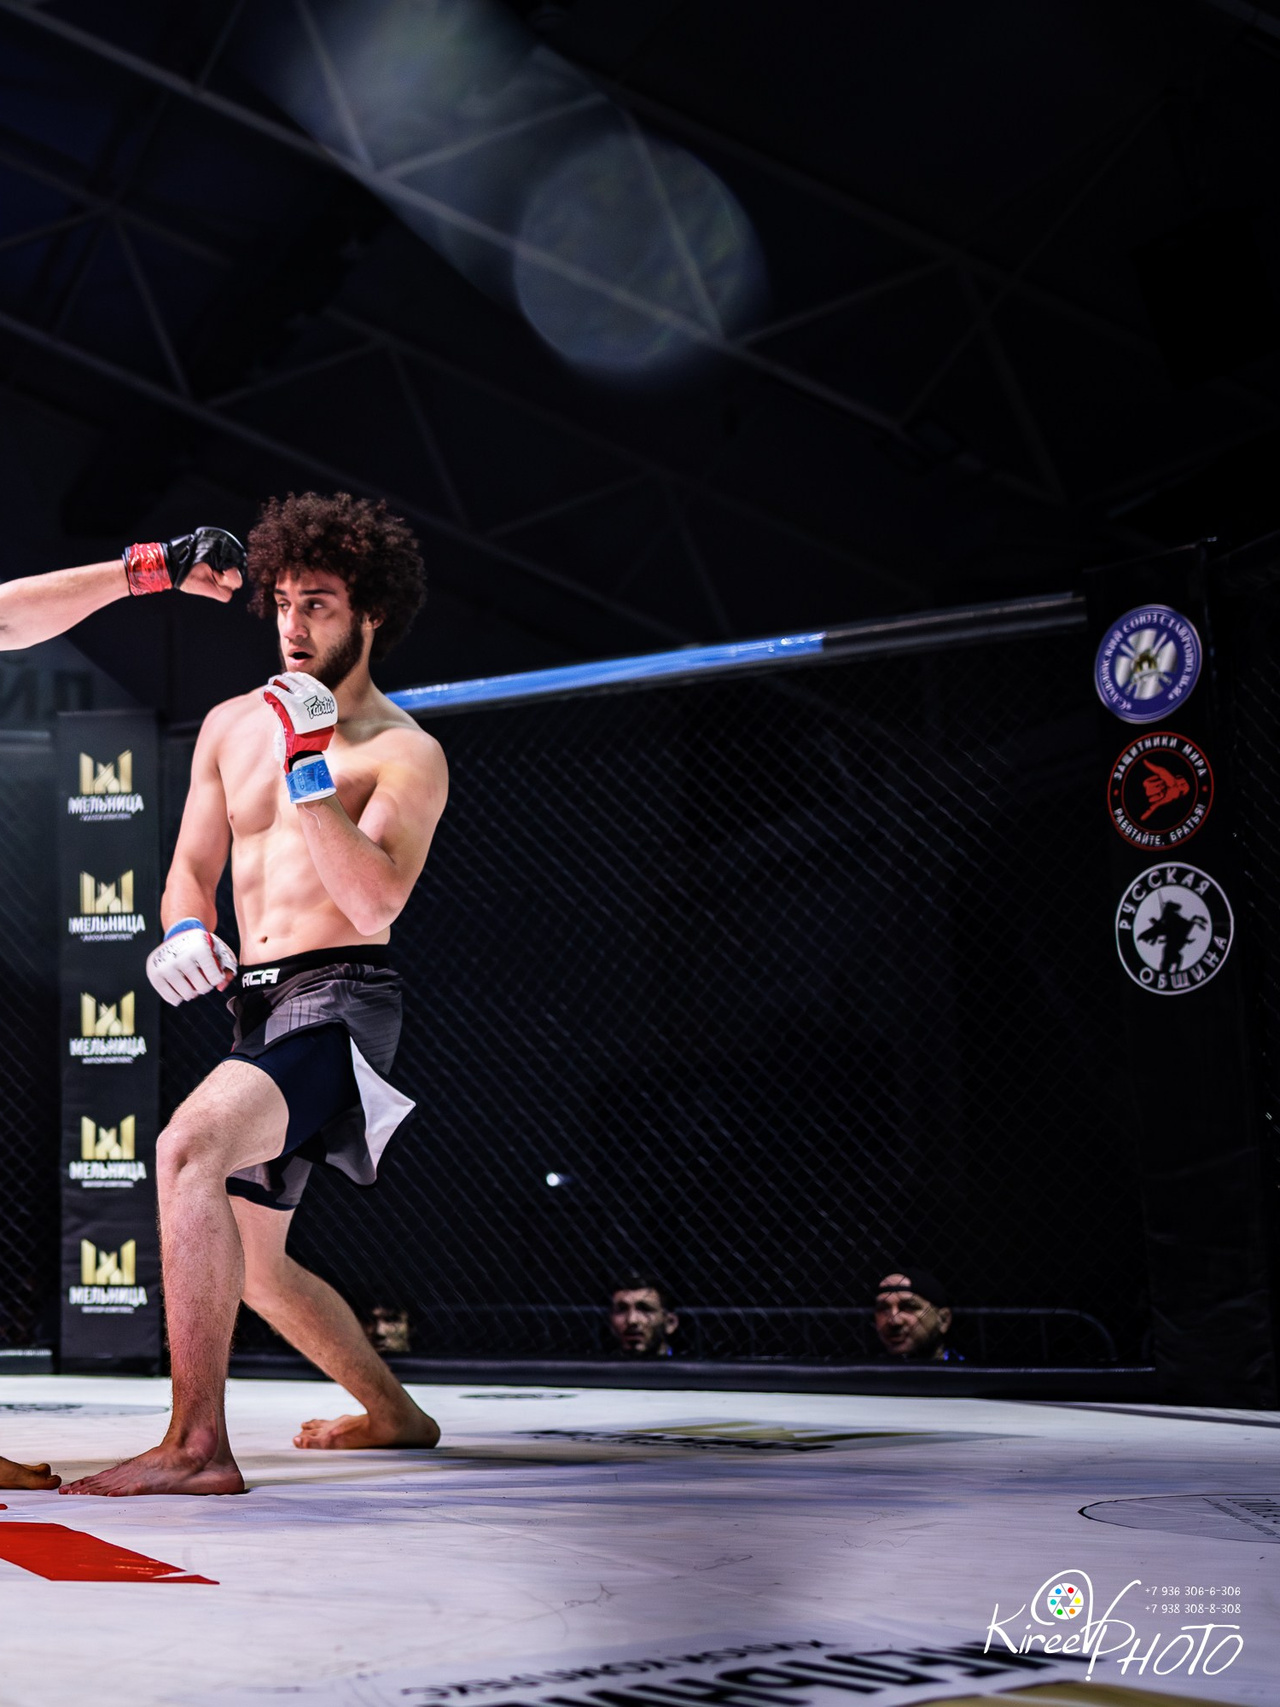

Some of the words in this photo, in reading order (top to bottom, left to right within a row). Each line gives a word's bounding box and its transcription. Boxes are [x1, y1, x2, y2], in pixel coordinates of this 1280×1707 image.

[1113, 736, 1178, 780] ЗАЩИТНИКИ
[1181, 743, 1208, 776] МИРА
[68, 793, 144, 814] МЕЛЬНИЦА
[1119, 867, 1211, 930] РУССКАЯ
[68, 913, 146, 934] МЕЛЬНИЦА
[1139, 935, 1227, 989] ОБЩИНА
[241, 968, 280, 988] ACA
[69, 1036, 147, 1057] МЕЛЬНИЦА
[69, 1161, 147, 1182] МЕЛЬНИЦА
[69, 1286, 148, 1307] МЕЛЬНИЦА
